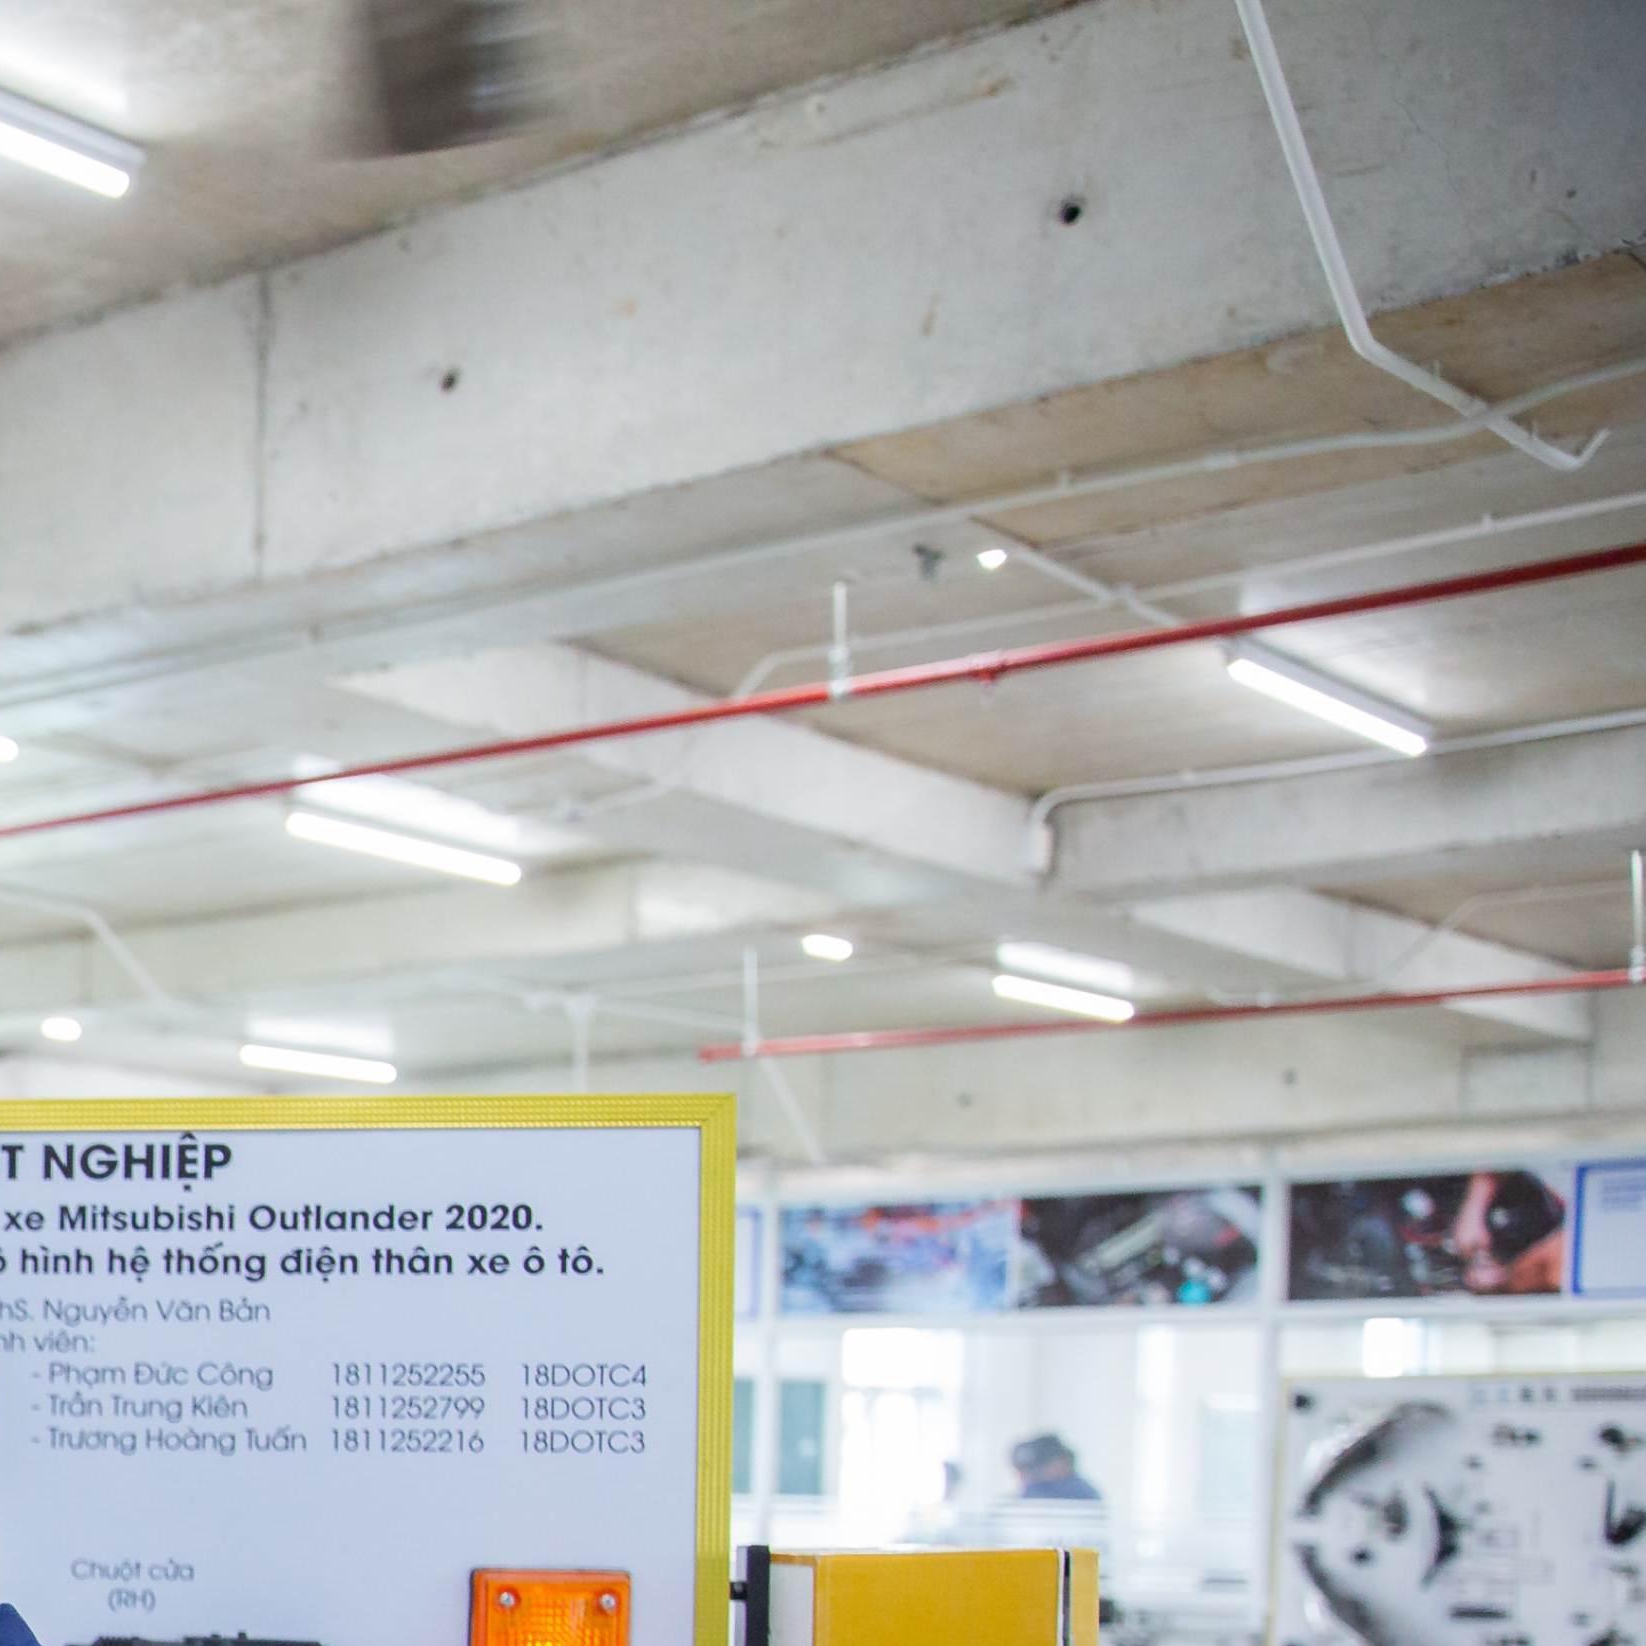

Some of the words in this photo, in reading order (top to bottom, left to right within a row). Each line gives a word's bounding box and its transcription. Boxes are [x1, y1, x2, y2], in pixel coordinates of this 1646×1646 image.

[43, 1131, 232, 1191] NGHIỆP
[4, 1210, 44, 1231] xe
[59, 1204, 234, 1231] Mitsubishi
[249, 1204, 433, 1231] Outlander
[445, 1204, 543, 1231] 2020.
[21, 1245, 93, 1274] hình
[109, 1246, 149, 1282] hệ
[162, 1241, 266, 1282] thống
[281, 1246, 358, 1282] điện
[372, 1246, 453, 1274] thân
[467, 1253, 509, 1274] xe
[523, 1246, 544, 1274] ô
[557, 1246, 604, 1274] tô.
[43, 1296, 147, 1328] Nguyễn
[155, 1299, 211, 1322] Văn
[33, 1332, 95, 1352] viên:
[49, 1363, 125, 1388] Phạm
[134, 1362, 188, 1385] Đức
[197, 1363, 273, 1391] Công
[332, 1362, 485, 1387] 1811252255
[522, 1362, 647, 1387] 18DOTC4
[48, 1391, 102, 1417] Trần
[111, 1396, 183, 1424] Trung
[191, 1395, 248, 1418] Kiên
[332, 1395, 485, 1420] 1811252799
[521, 1396, 646, 1420] 18DOTC3
[48, 1427, 137, 1455] Trương
[145, 1427, 236, 1455] Hoàng
[245, 1425, 307, 1451] Tuấn
[332, 1428, 485, 1453] 1811252216
[521, 1429, 645, 1454] 18DOTC3
[71, 1558, 139, 1586] Chuột
[149, 1557, 195, 1582] cửa
[108, 1588, 156, 1612] (RH)
